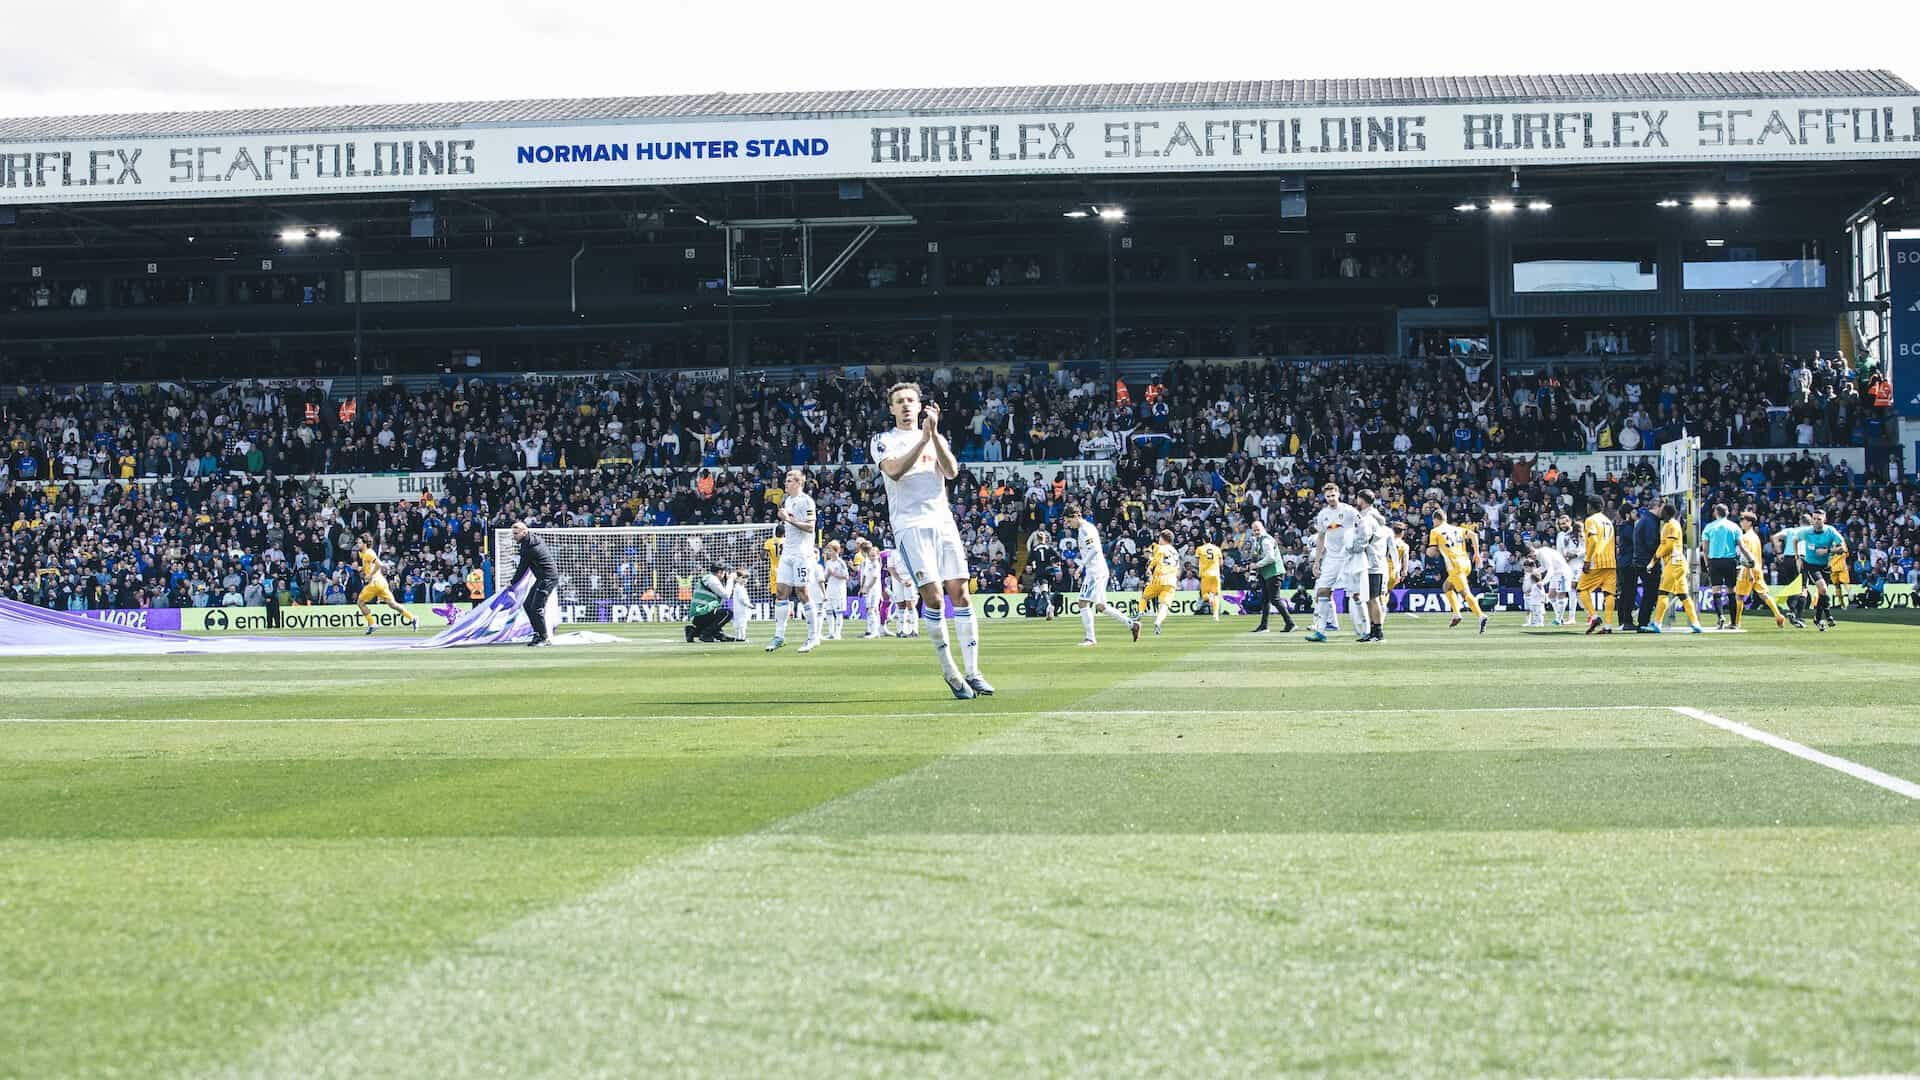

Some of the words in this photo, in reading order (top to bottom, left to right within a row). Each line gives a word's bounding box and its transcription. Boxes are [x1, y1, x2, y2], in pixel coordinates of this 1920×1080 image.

[870, 122, 1075, 163] BURFLEX
[1104, 116, 1426, 157] SCAFFOLDING
[1463, 110, 1669, 149] BURFLEX
[170, 139, 475, 182] SCAFFOLDING
[517, 143, 628, 163] NORMAN
[636, 139, 738, 160] HUNTER
[745, 137, 829, 157] STAND
[797, 567, 807, 578] 15
[235, 611, 365, 628] emloyment
